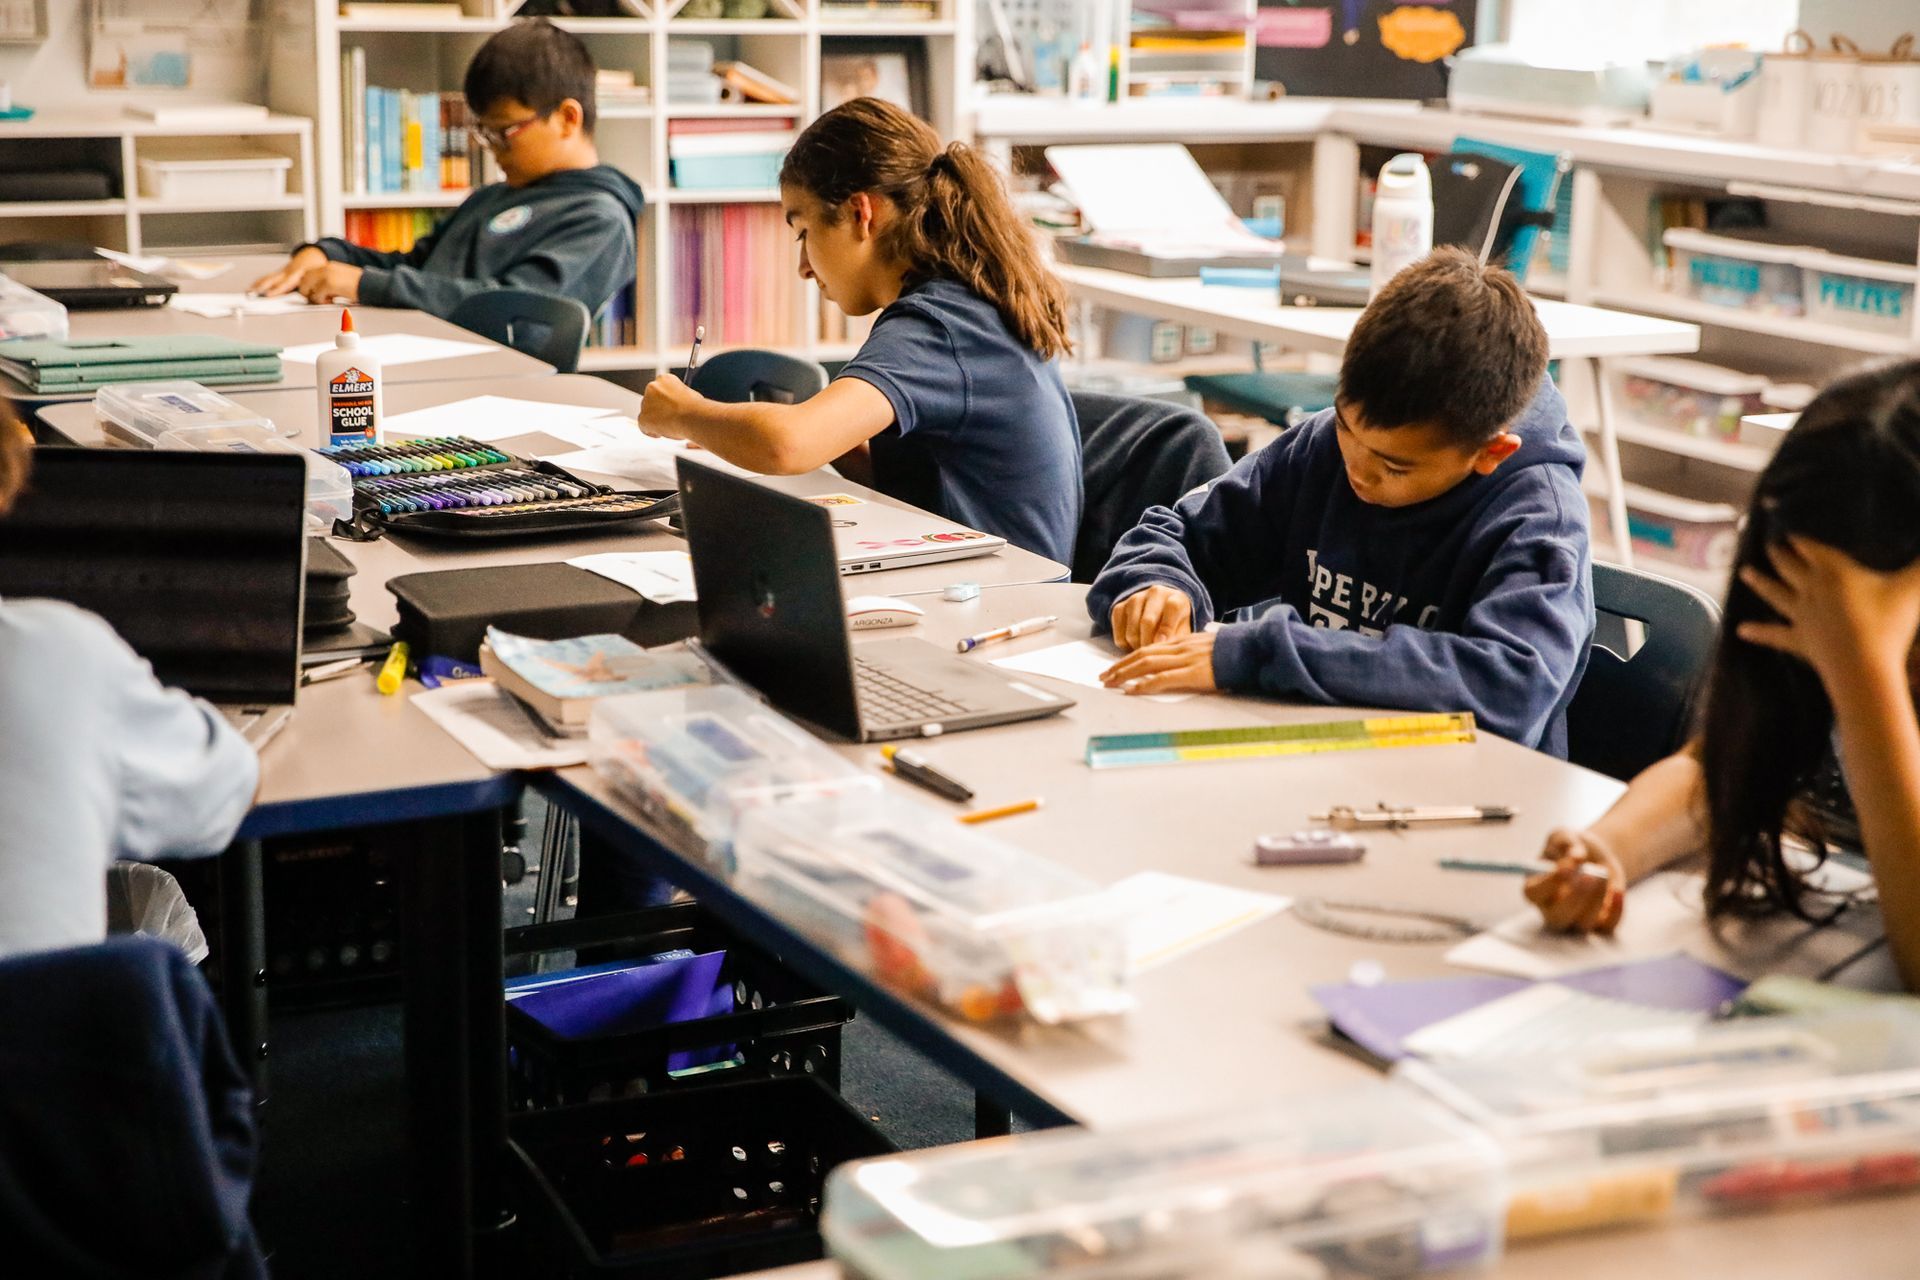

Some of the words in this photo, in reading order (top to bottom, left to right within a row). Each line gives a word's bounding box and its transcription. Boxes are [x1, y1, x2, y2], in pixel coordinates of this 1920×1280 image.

[1819, 276, 1901, 317] PRIZES
[331, 381, 373, 393] ELMER'S
[333, 406, 374, 417] SCHOOL
[341, 417, 367, 427] GLUE
[853, 617, 893, 626] ARGONZA
